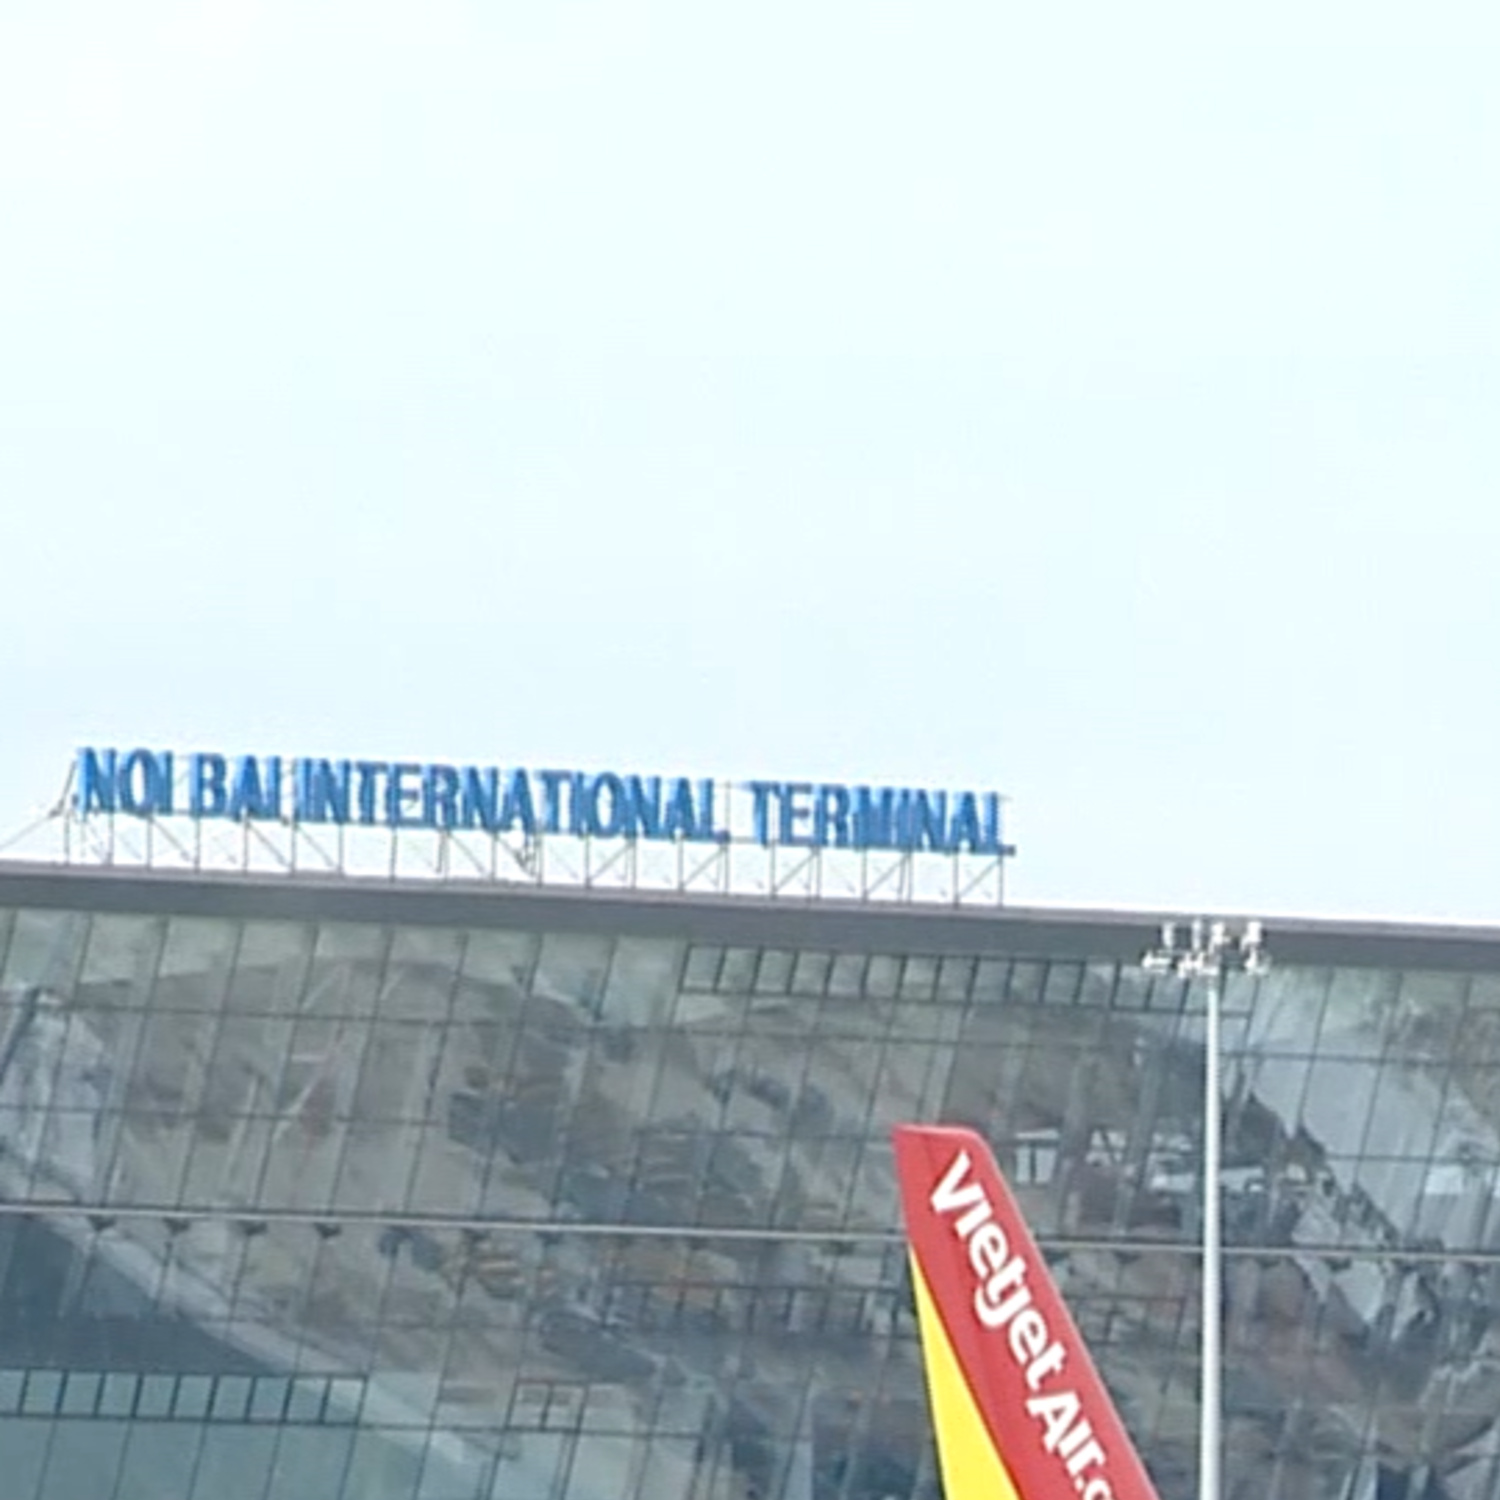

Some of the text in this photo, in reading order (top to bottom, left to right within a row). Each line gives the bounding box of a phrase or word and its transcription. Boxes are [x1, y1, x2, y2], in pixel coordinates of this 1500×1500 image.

[76, 746, 1016, 856] NOI BAI INTERNATIONAL TERMINAL
